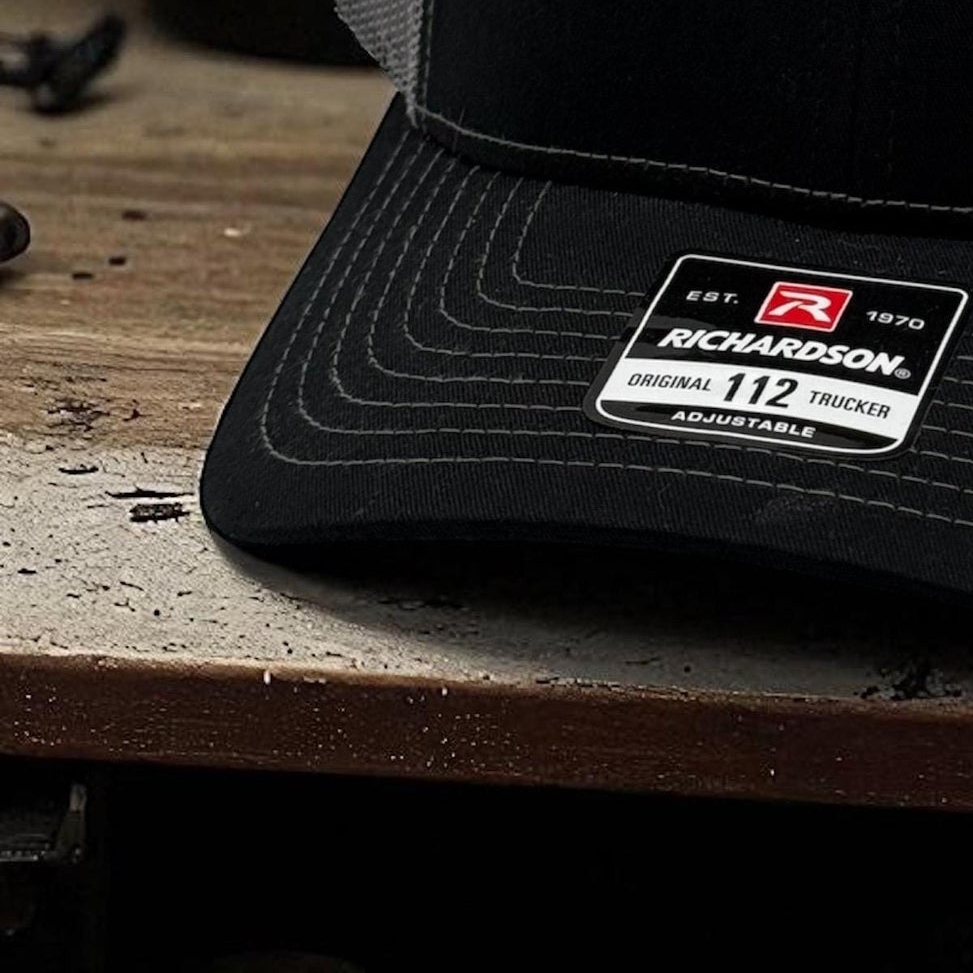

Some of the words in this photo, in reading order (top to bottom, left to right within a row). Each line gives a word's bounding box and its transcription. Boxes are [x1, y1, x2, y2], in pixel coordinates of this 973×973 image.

[686, 290, 739, 305] EST.
[866, 310, 926, 330] 1970
[627, 372, 713, 392] ORIGINAL
[723, 373, 798, 409] 112
[809, 390, 891, 420] TRUCKER
[671, 410, 817, 439] ADJUSTABLE
